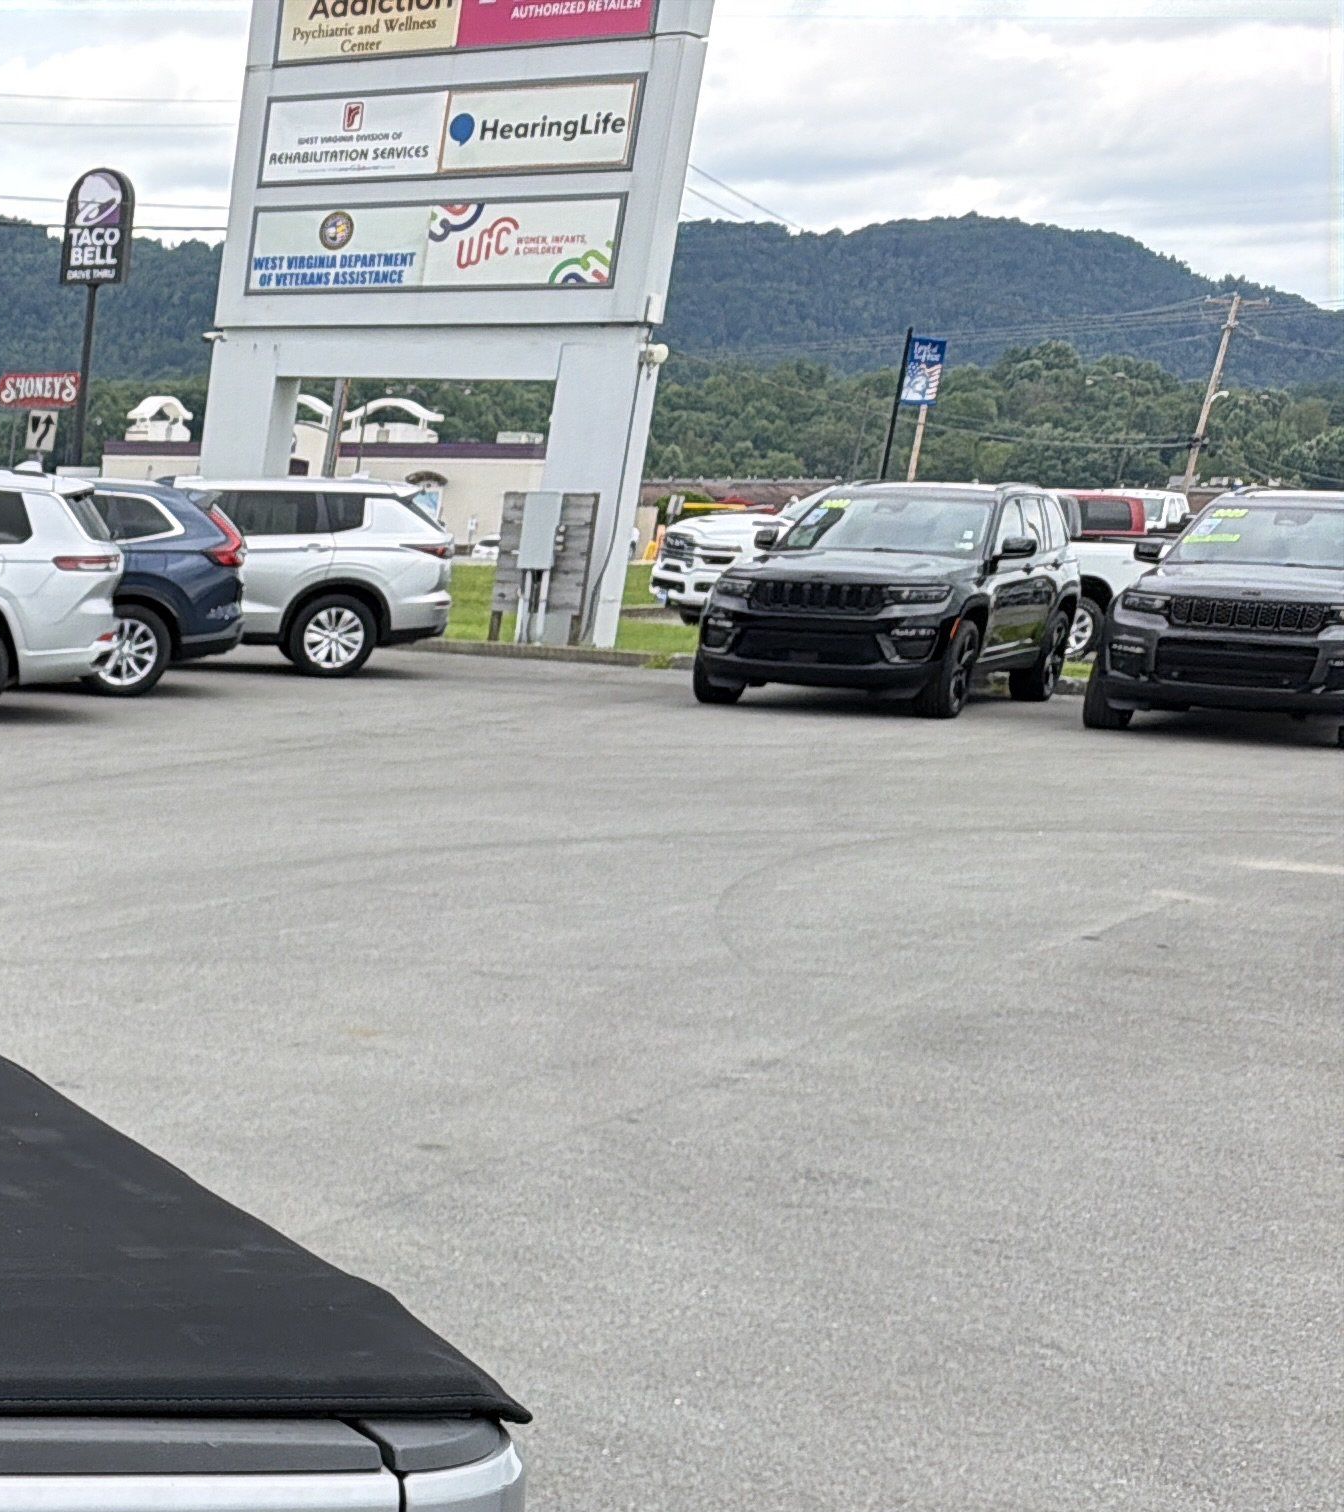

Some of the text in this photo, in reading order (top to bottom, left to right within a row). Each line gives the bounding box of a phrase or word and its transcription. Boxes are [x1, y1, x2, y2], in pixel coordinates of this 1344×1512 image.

[309, 0, 452, 20] Addiction
[511, 0, 641, 19] AUTHORIZED RETAILER
[292, 16, 437, 45] Psychiatric and Wellness
[340, 39, 382, 53] Center
[479, 112, 625, 142] HearingLife
[356, 132, 389, 142] DIVISION
[392, 132, 402, 140] OF
[269, 145, 429, 165] REHABILITATION SERVICES
[69, 227, 120, 246] TACO
[70, 245, 118, 266] BELL
[523, 246, 563, 256] CHILDREN
[253, 252, 416, 270] WEST VIRGINIA DEPARTMENT
[259, 269, 405, 287] OF VETERANS ASSISTANCE
[0, 375, 77, 404] SHONEY'S
